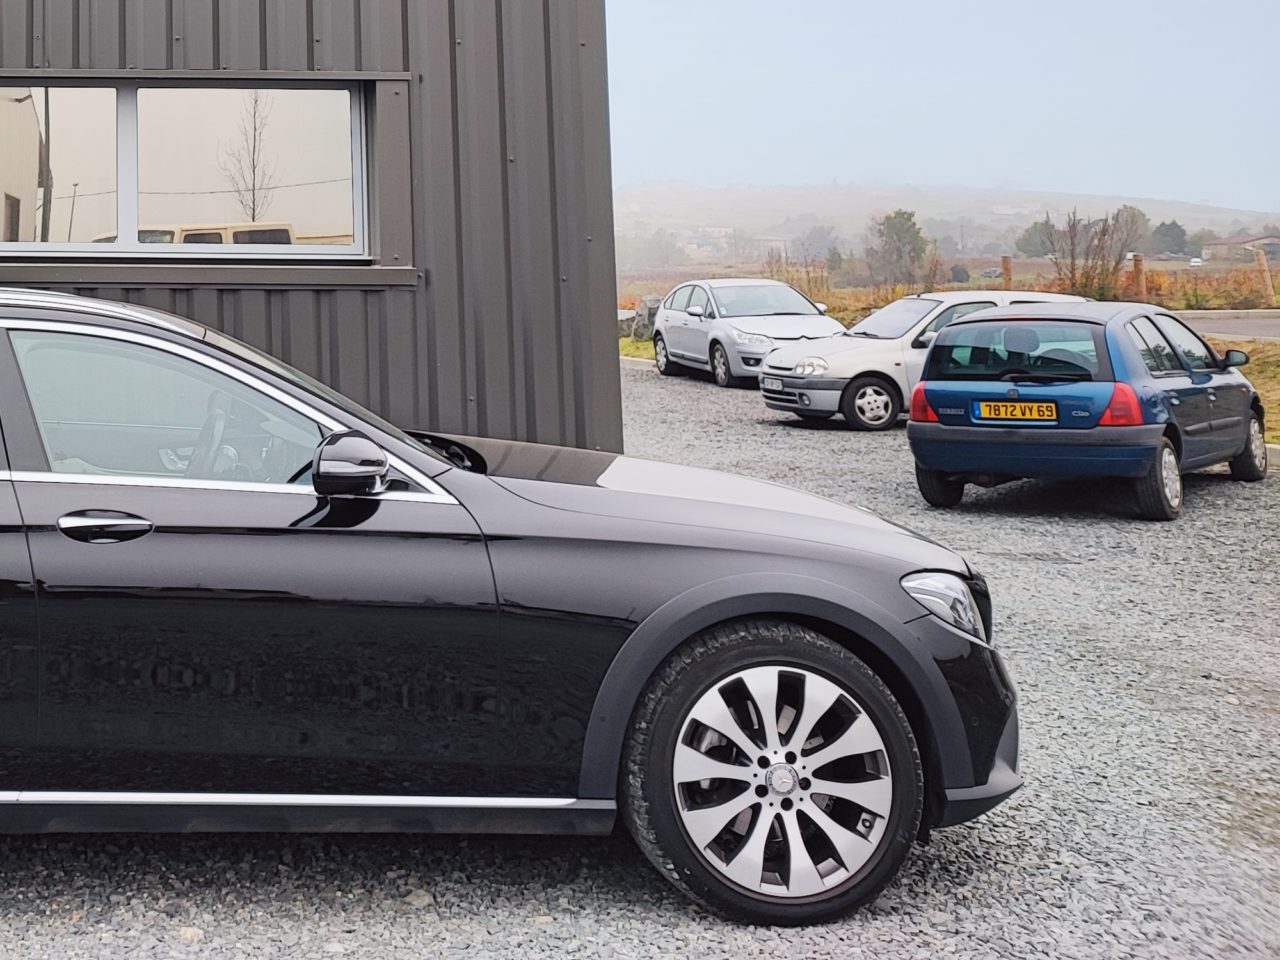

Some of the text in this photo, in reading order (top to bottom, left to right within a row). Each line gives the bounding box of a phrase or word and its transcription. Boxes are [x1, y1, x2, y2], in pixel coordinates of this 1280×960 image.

[984, 403, 1054, 418] 7872 VY 69
